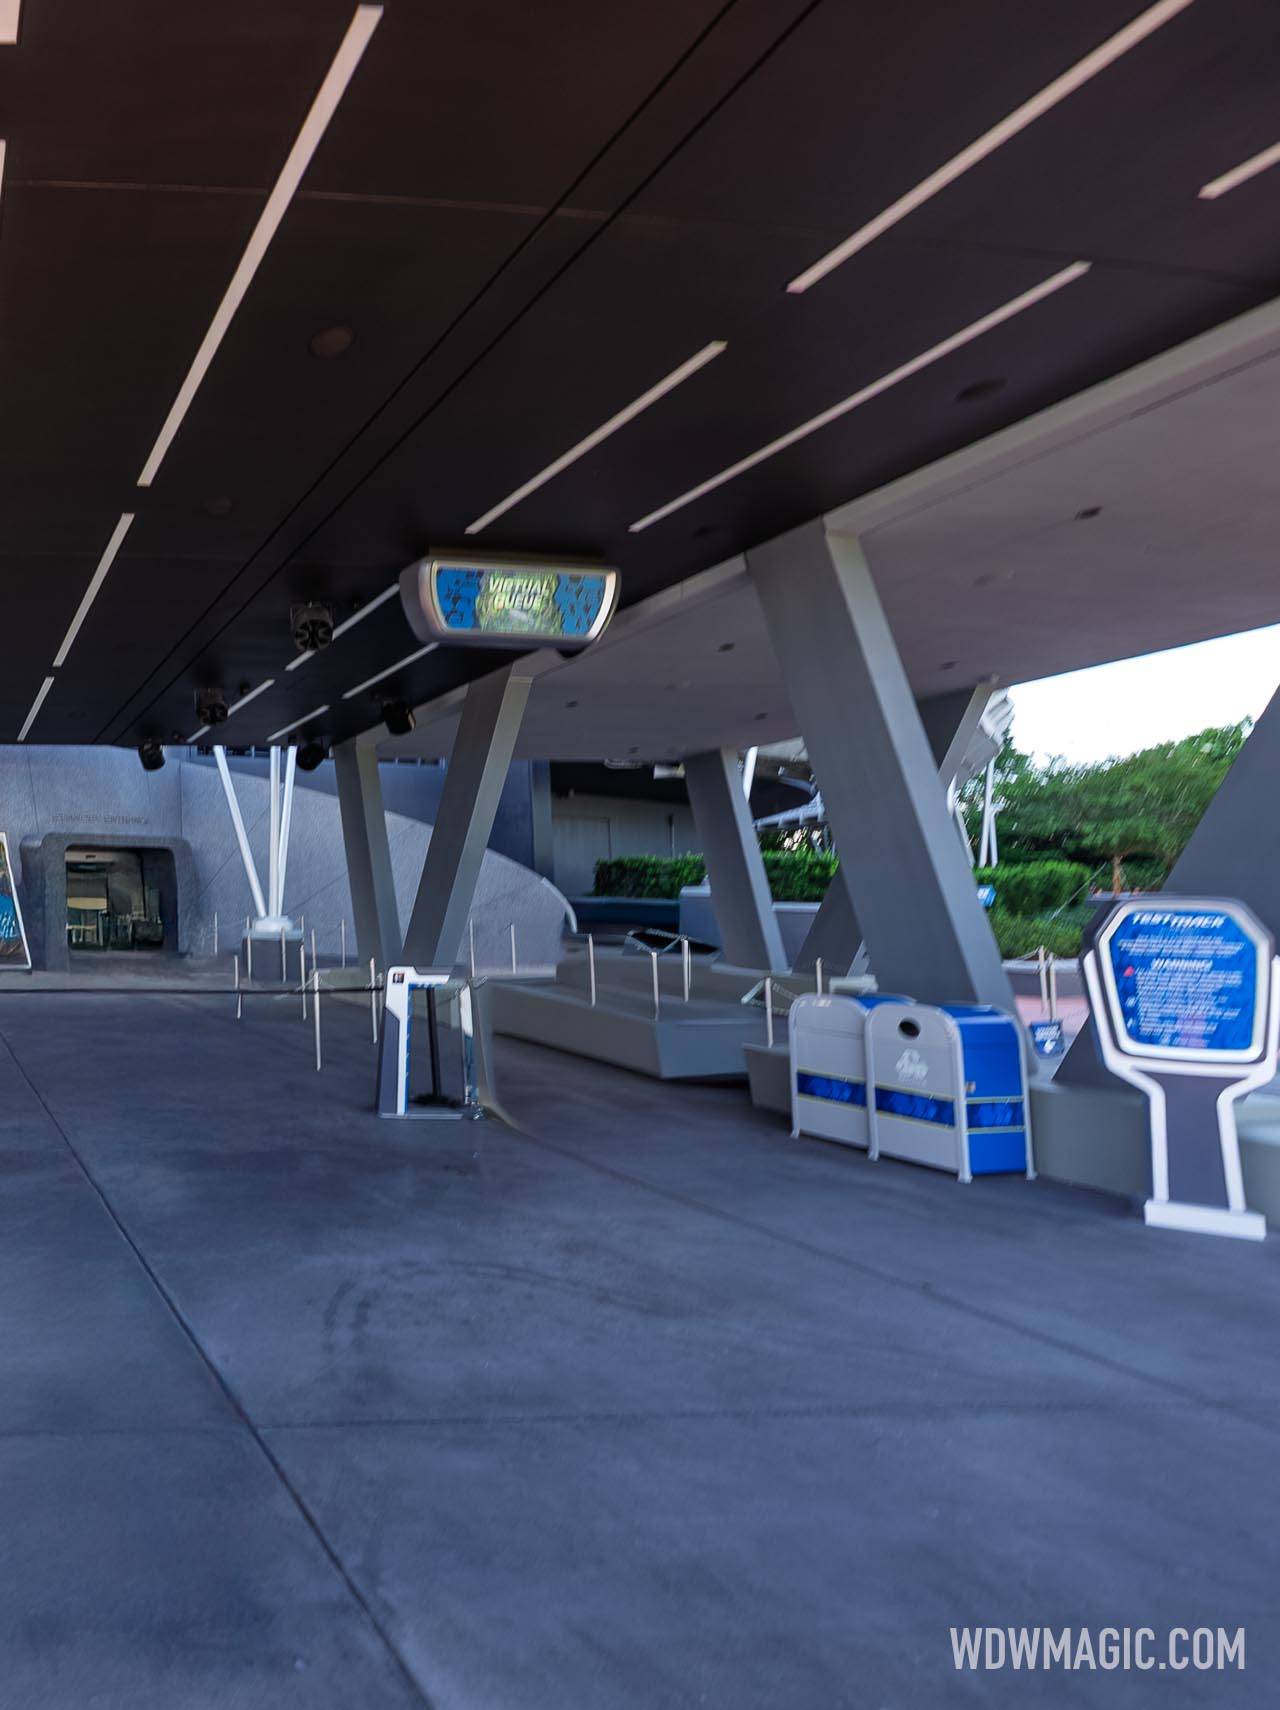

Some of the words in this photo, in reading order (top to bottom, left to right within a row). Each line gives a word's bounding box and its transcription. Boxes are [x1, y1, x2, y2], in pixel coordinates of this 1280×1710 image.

[488, 576, 550, 595] VIRTUAL
[494, 592, 543, 611] QUEUE
[1132, 912, 1174, 926] TEST
[1169, 915, 1227, 929] TRACK
